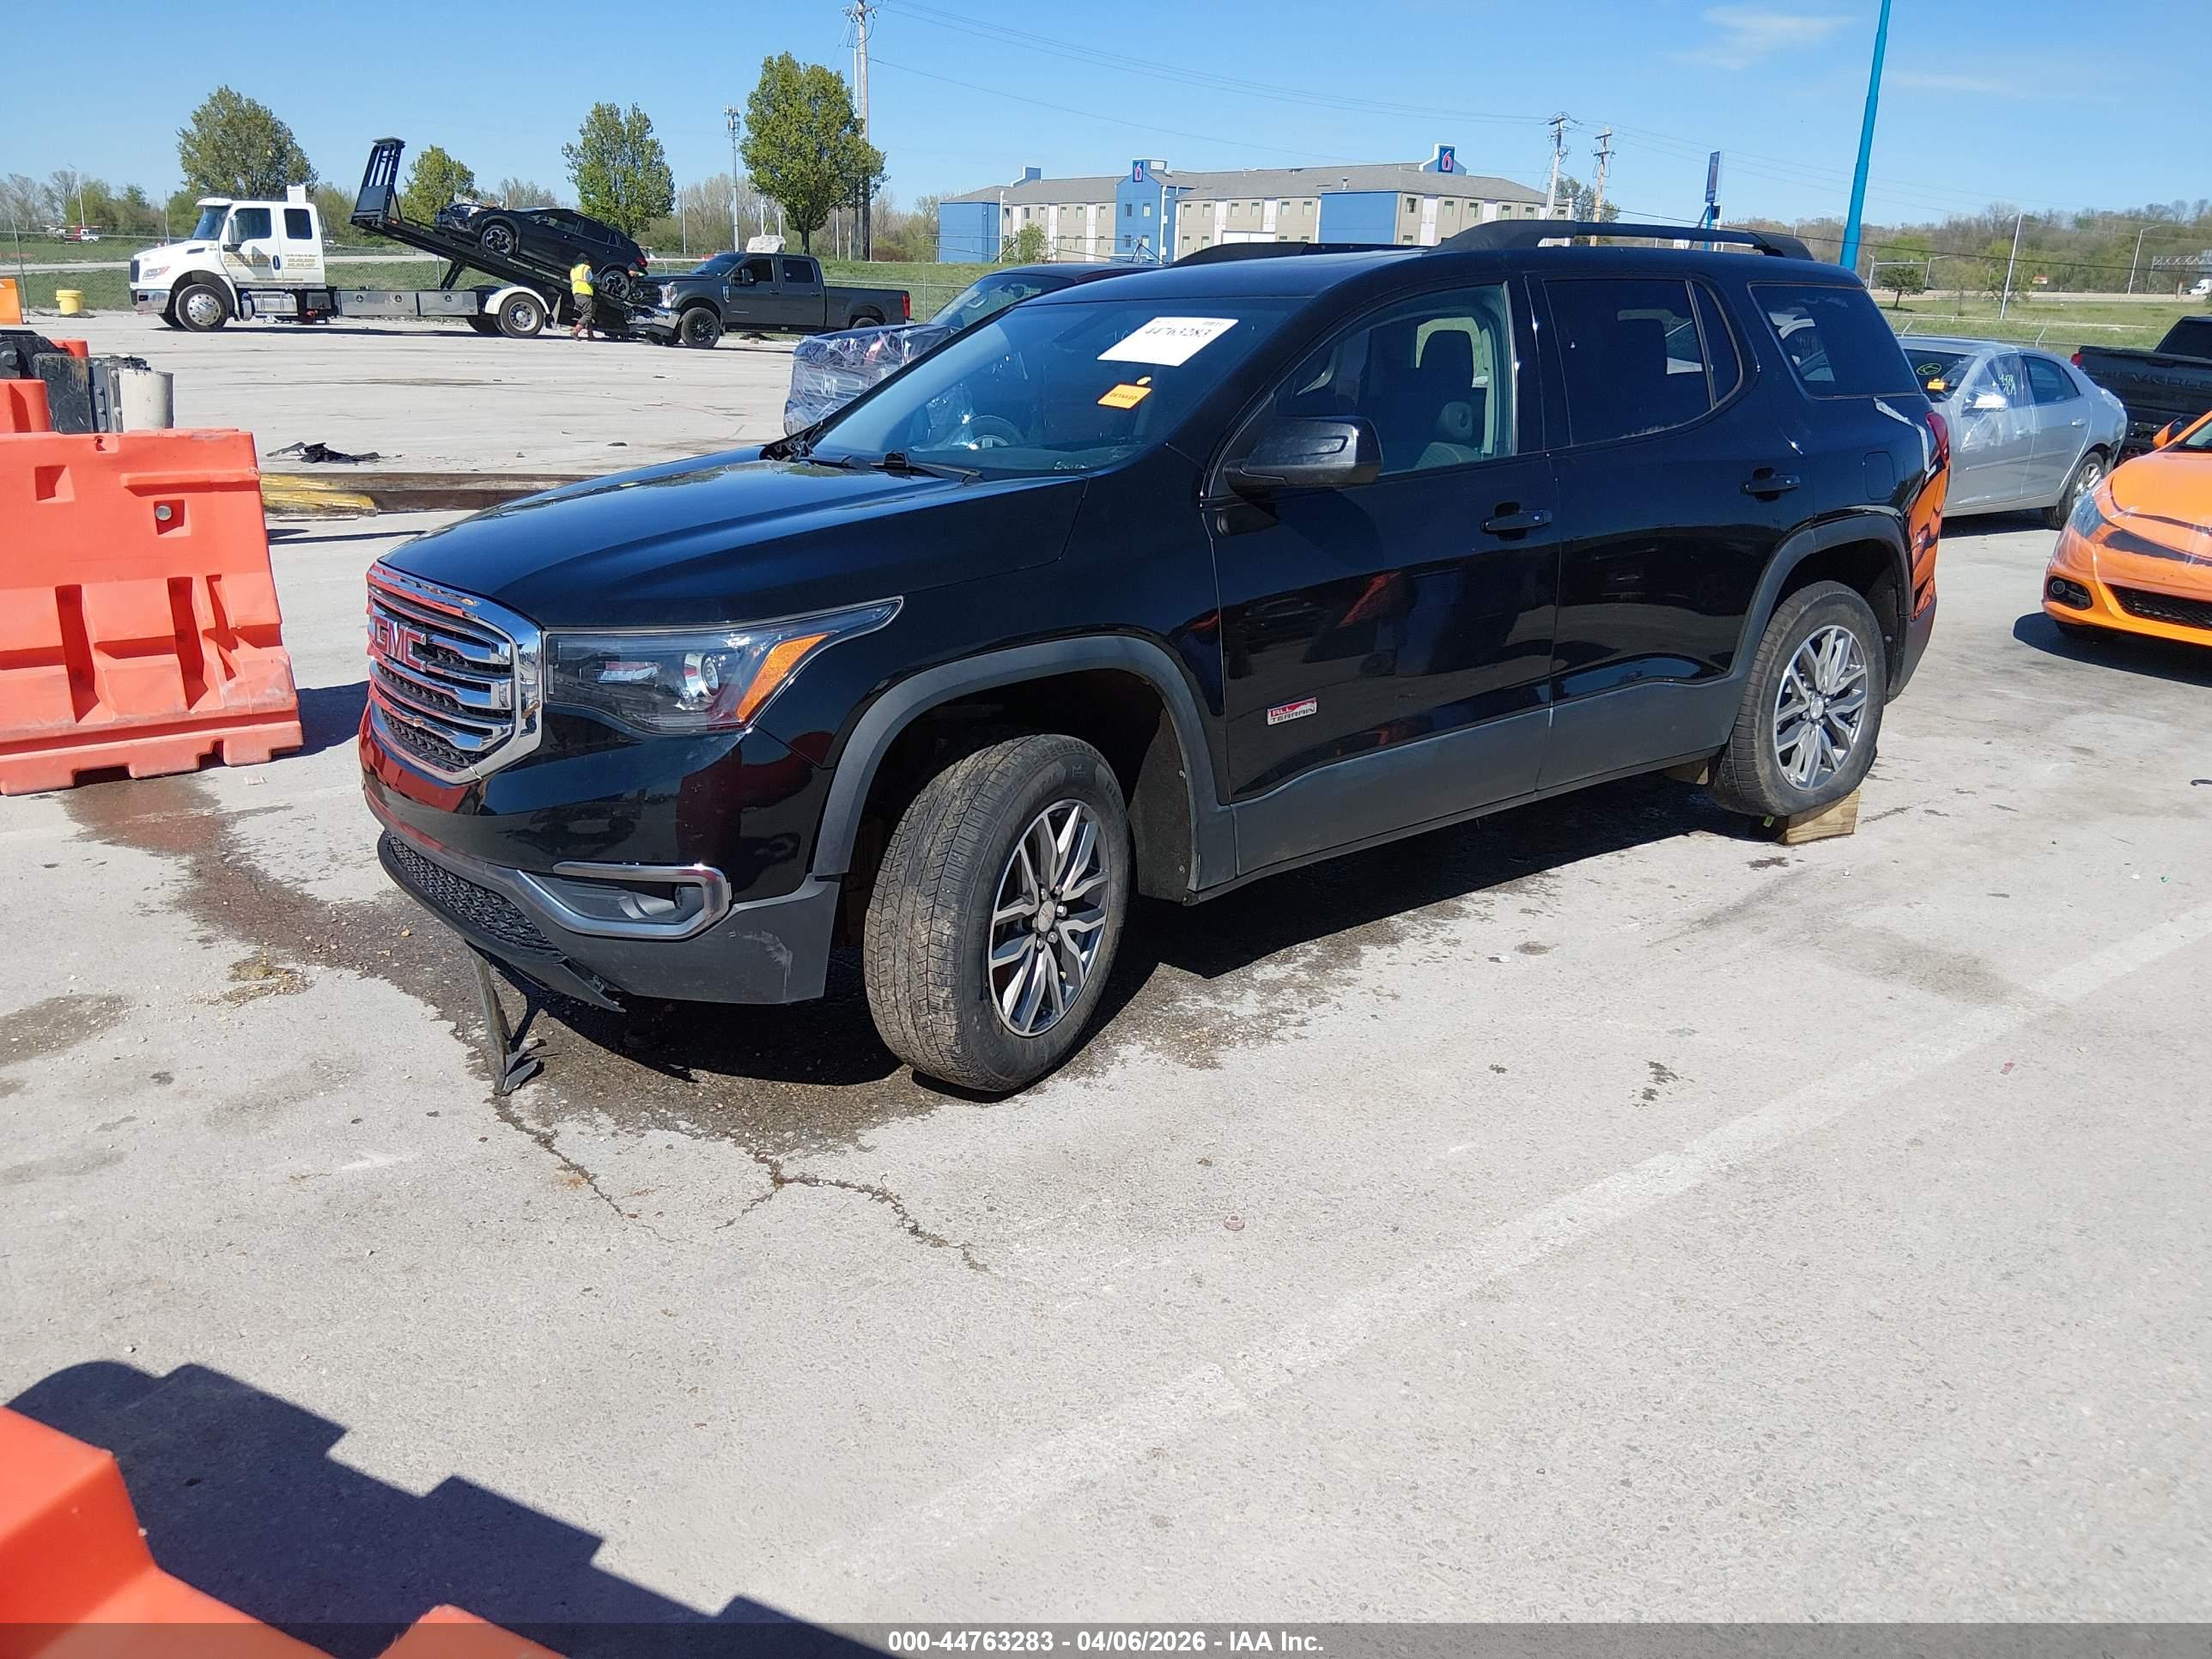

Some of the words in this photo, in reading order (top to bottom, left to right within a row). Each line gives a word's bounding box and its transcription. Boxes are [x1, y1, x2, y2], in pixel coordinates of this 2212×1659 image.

[1442, 149, 1453, 171] 6
[1134, 162, 1142, 181] 6
[374, 617, 427, 672] GMC
[1271, 707, 1316, 722] TERRAIN
[1273, 707, 1292, 716] ALL
